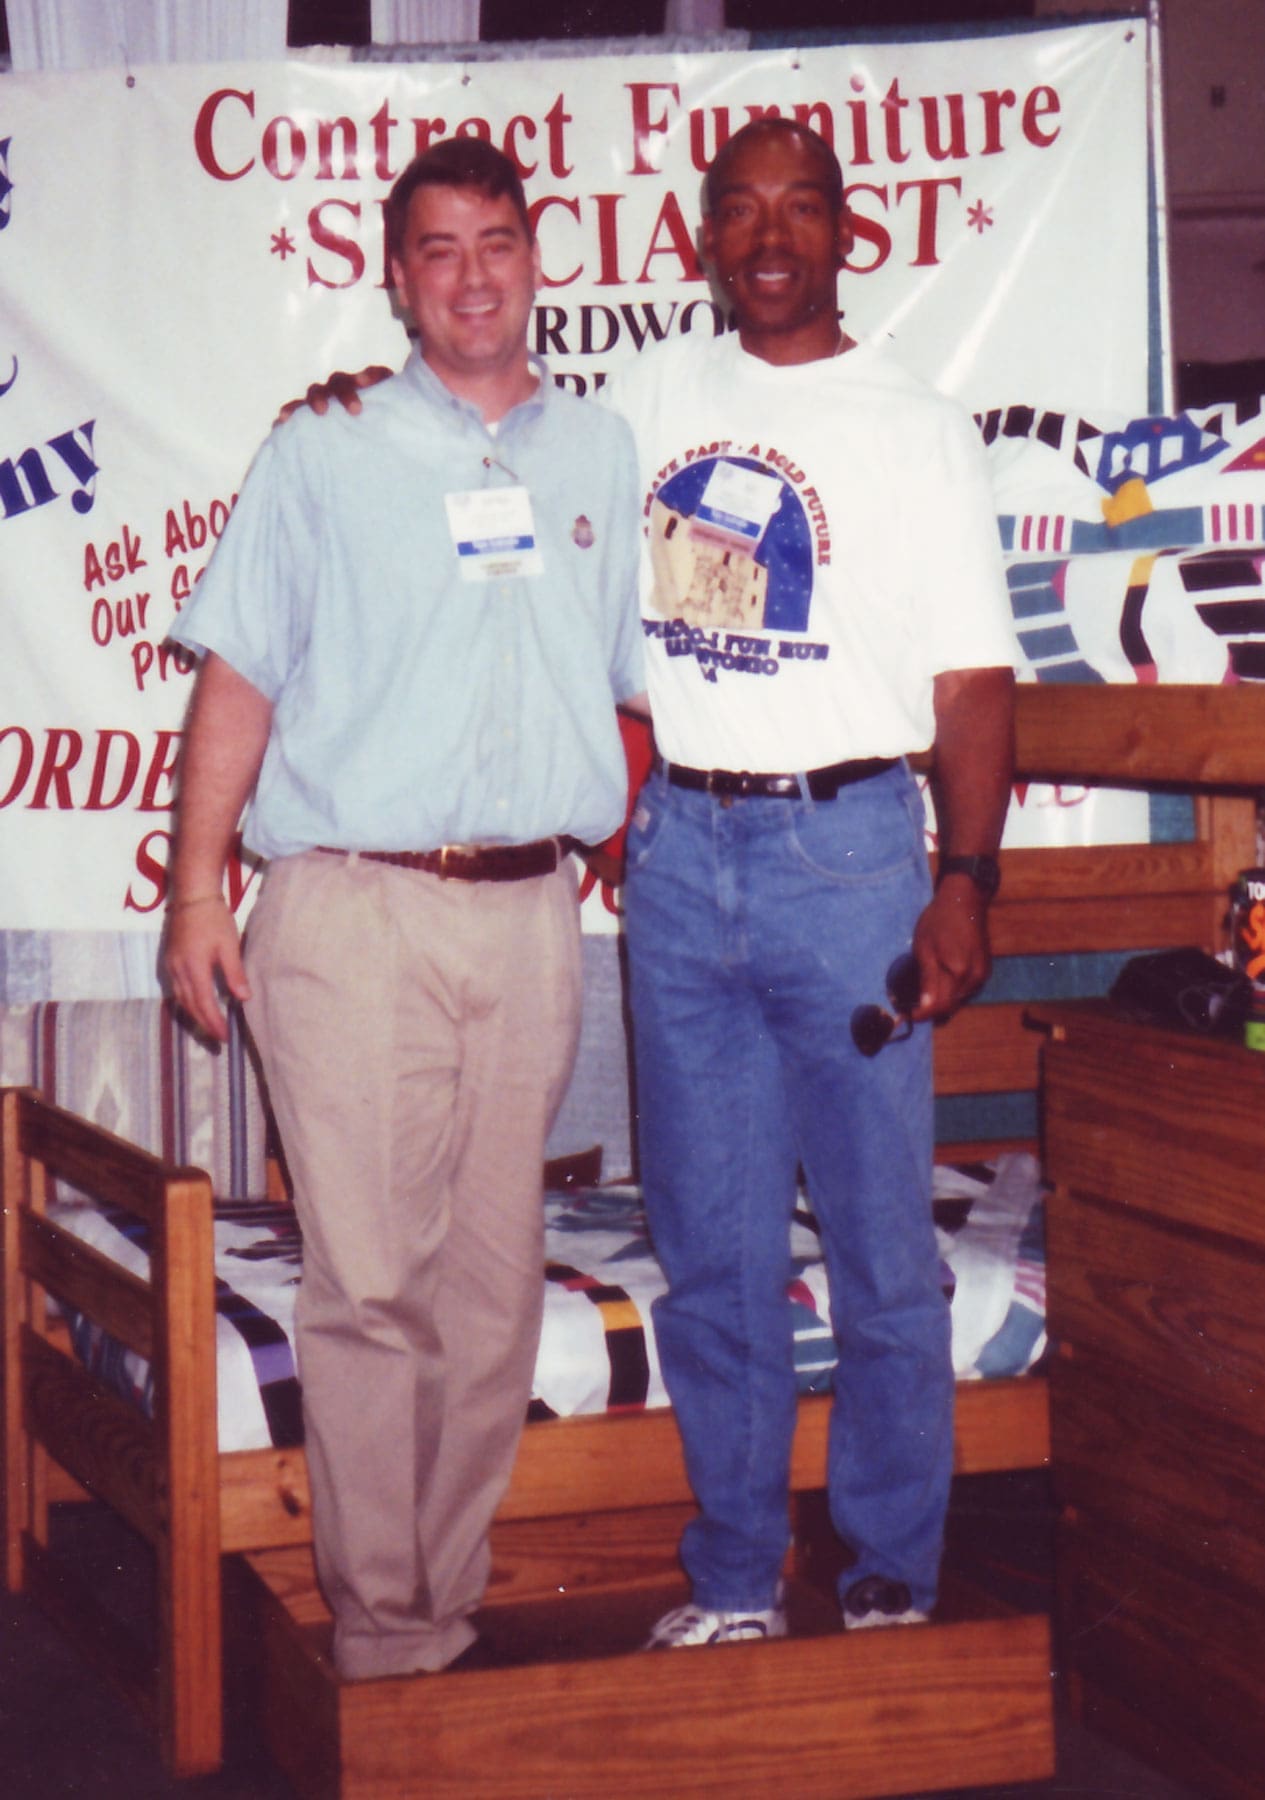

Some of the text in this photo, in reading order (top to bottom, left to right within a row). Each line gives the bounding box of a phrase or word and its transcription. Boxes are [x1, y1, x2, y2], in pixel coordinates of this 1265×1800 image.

[624, 75, 1062, 176] Funiture
[765, 447, 806, 484] BOLD
[802, 486, 831, 566] FUTURE
[84, 524, 148, 592] Ask
[91, 592, 151, 647] Our
